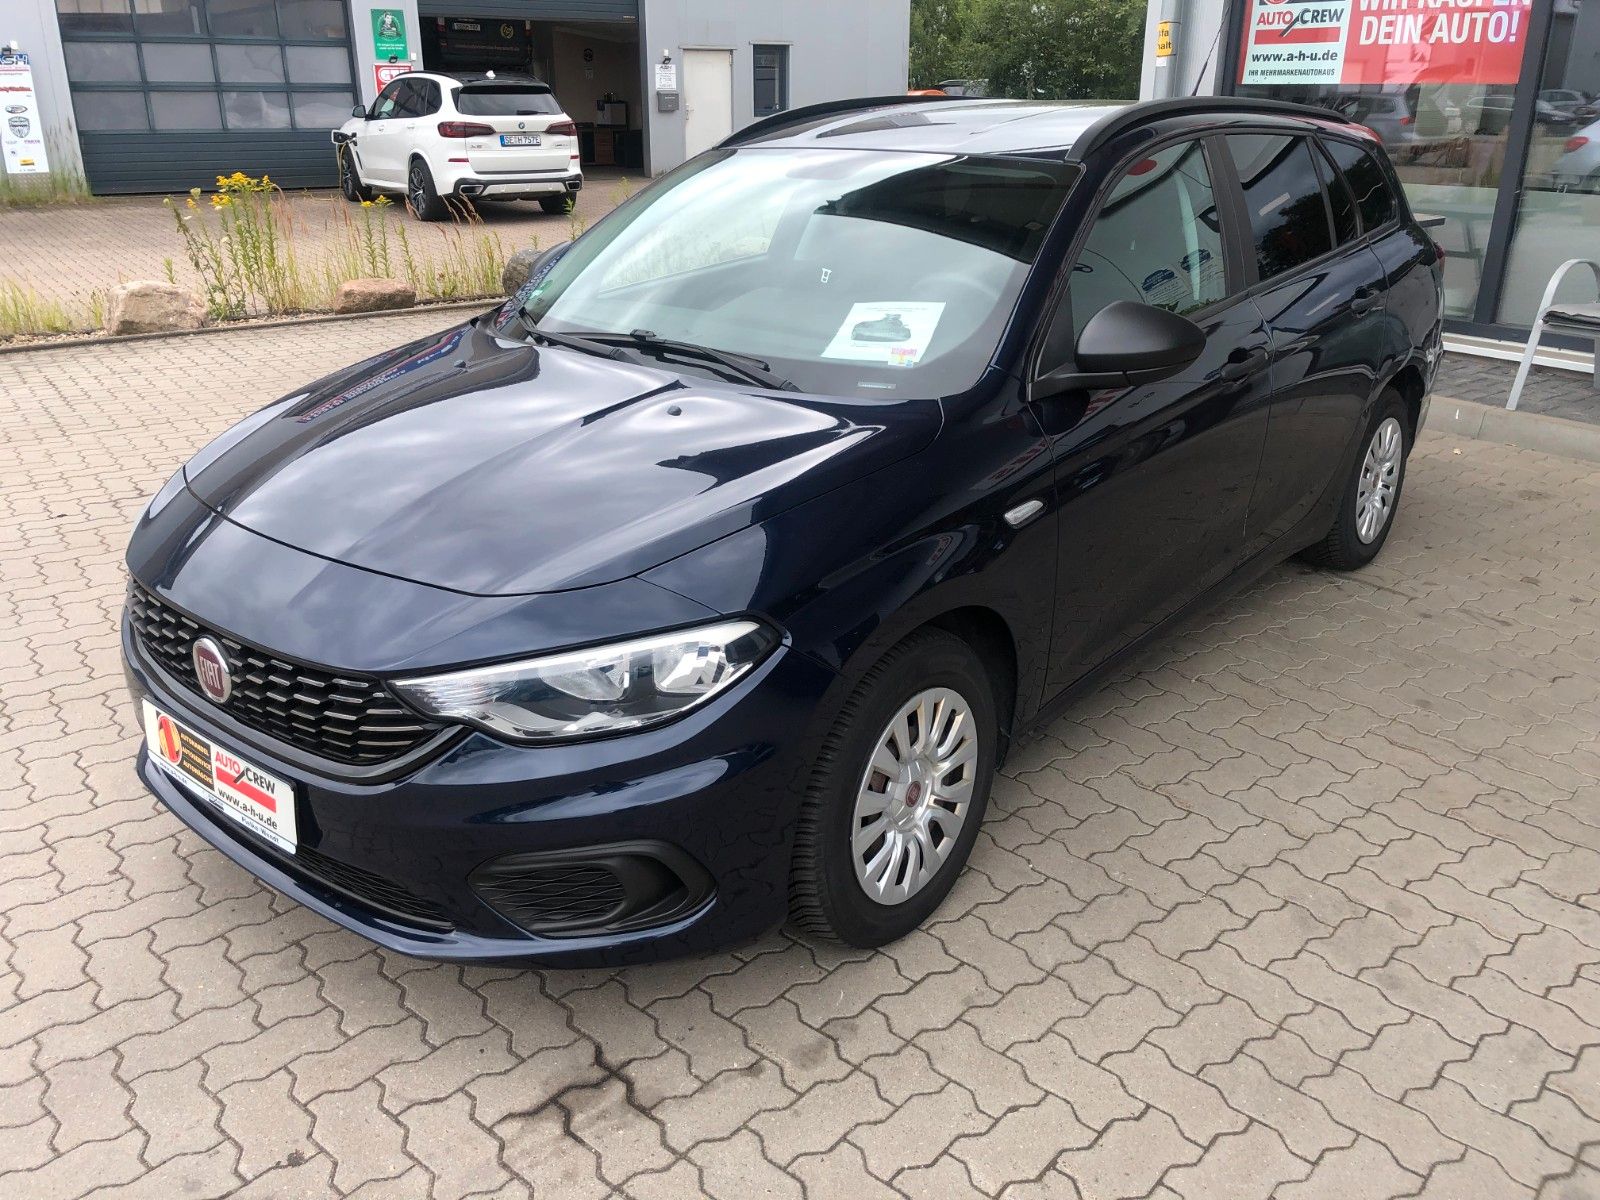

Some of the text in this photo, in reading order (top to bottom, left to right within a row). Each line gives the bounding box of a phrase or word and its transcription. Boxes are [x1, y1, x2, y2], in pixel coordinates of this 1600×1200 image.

[1256, 7, 1345, 26] AUTO CREW
[1359, 10, 1520, 45] DEIN AUTO!
[1251, 49, 1338, 62] www.a-h-u.de
[1260, 68, 1335, 77] MEHRMARKENAUTOHAUS
[199, 655, 222, 690] FIAT
[214, 751, 276, 795] AUTO CREW
[217, 787, 278, 830] www.a-h-u.de
